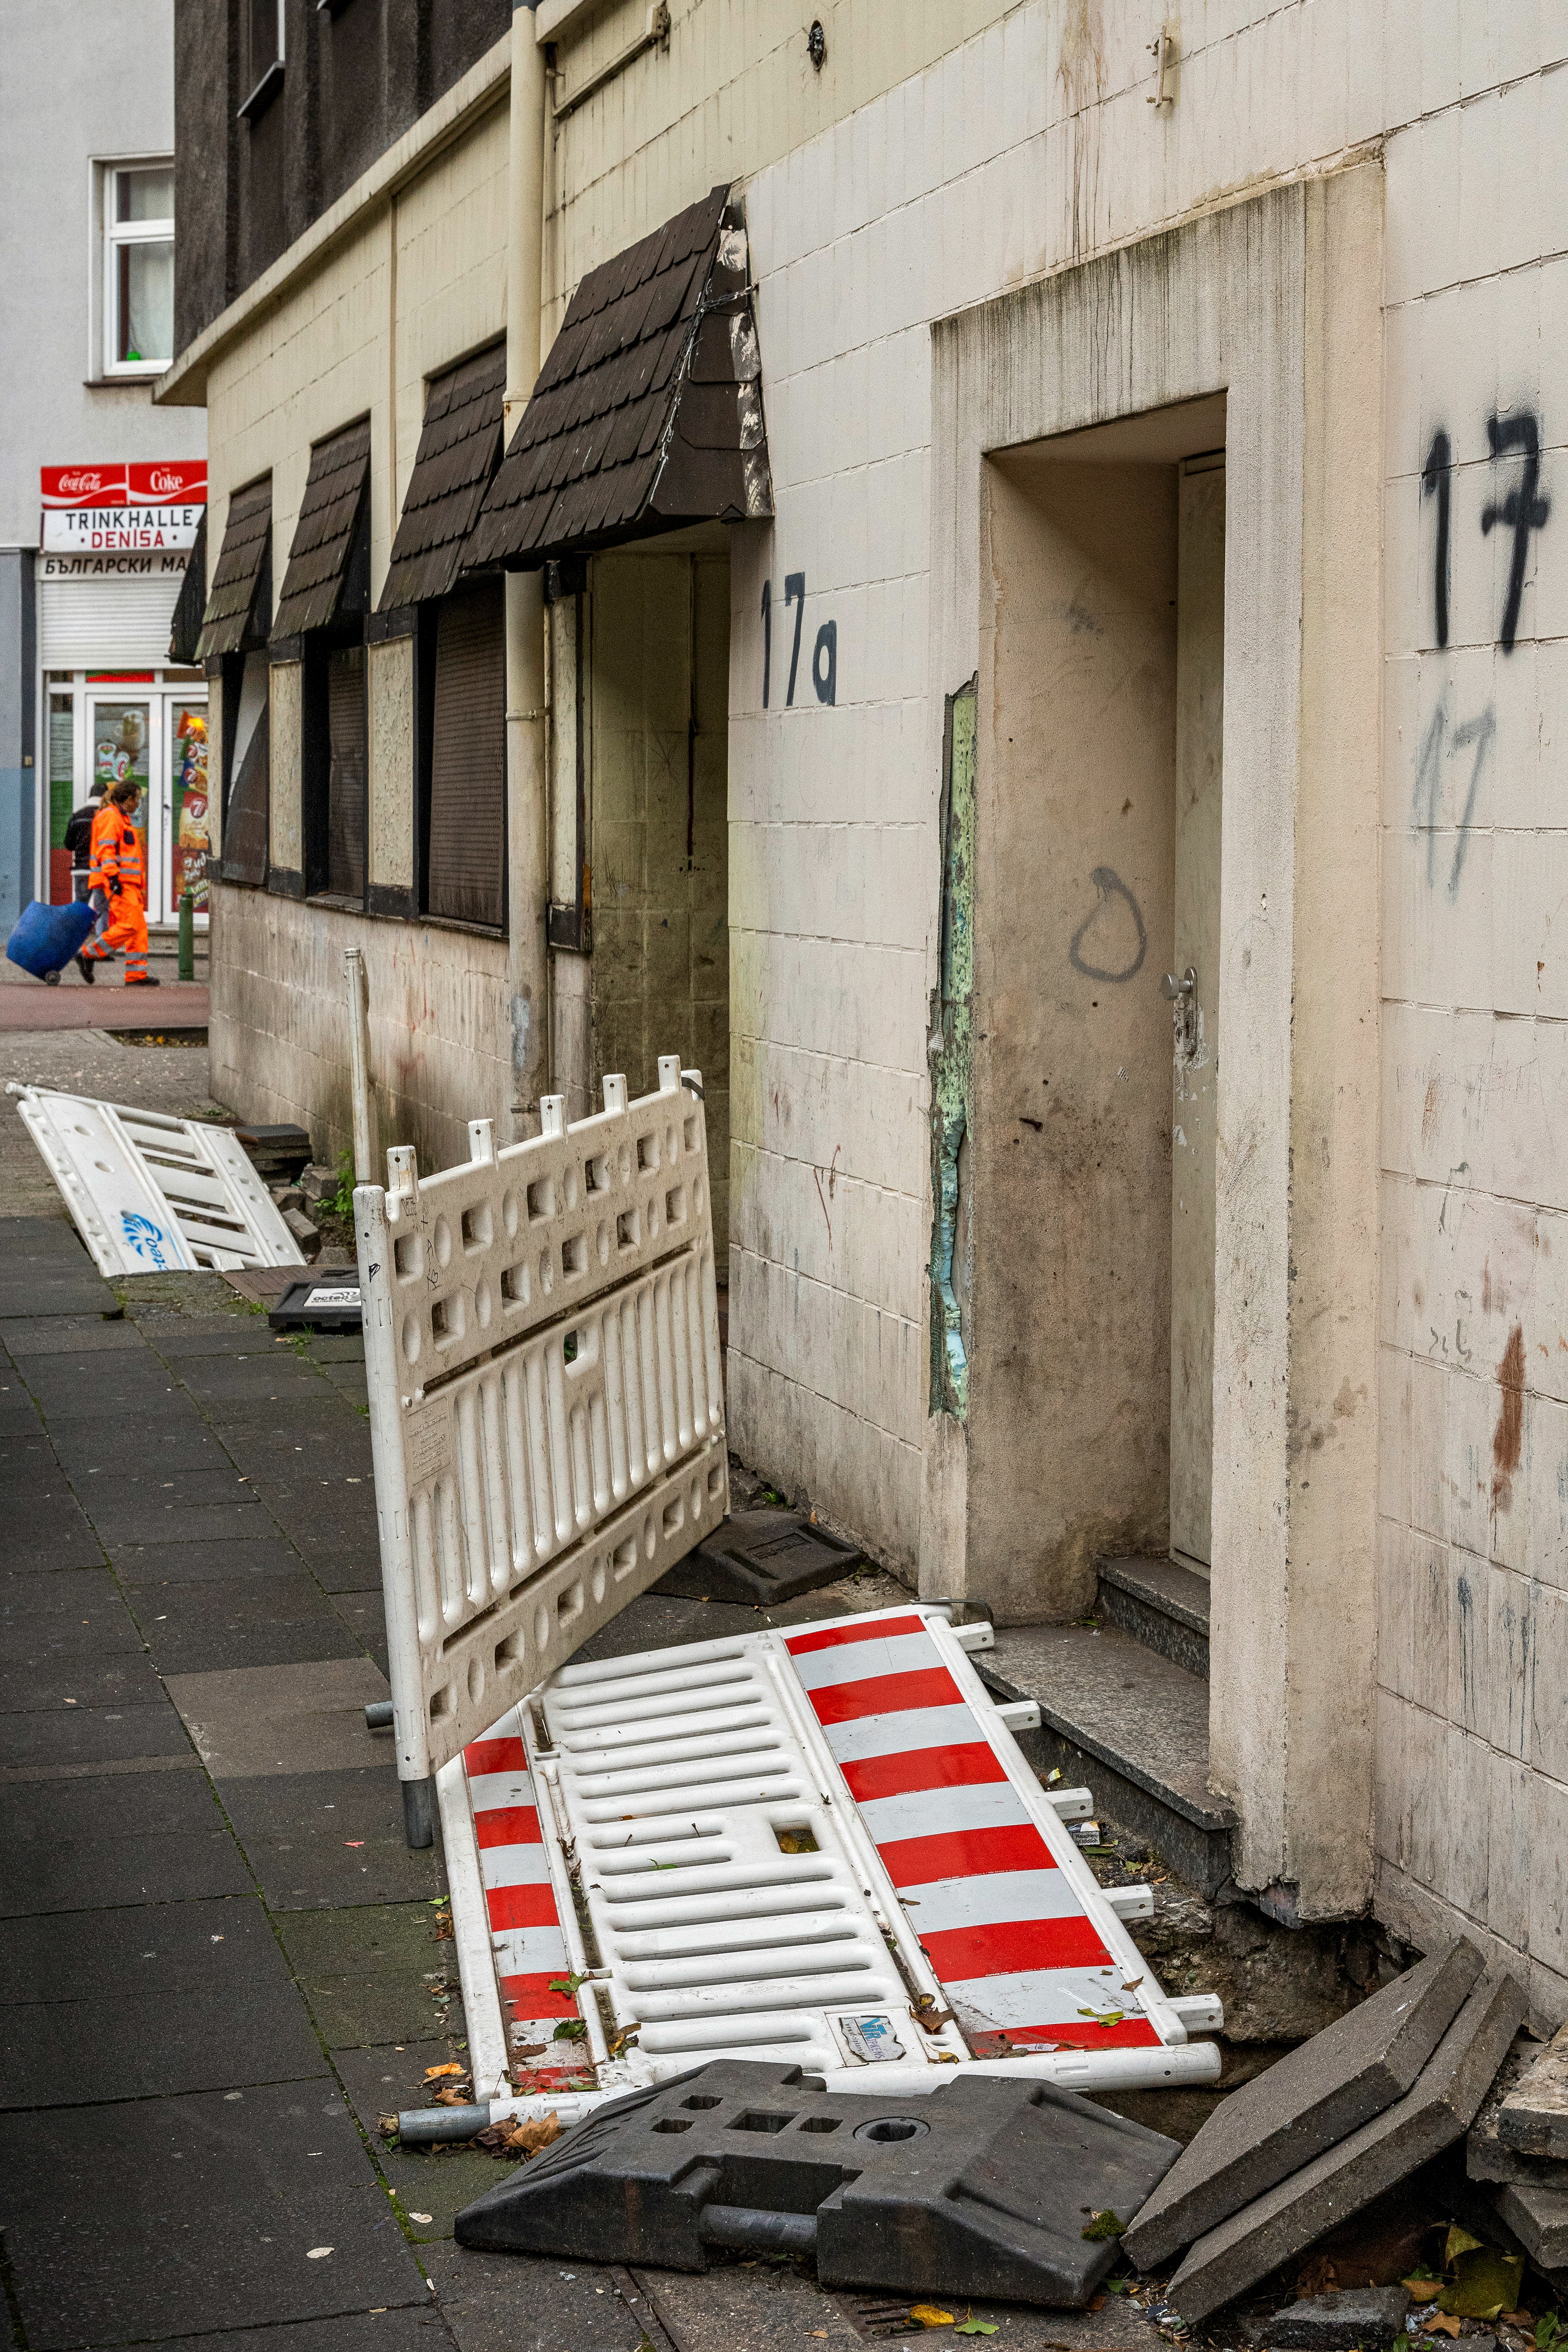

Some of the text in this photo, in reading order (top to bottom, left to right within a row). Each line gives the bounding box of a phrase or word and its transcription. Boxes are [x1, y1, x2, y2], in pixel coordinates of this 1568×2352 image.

[150, 470, 184, 492] Coke
[66, 509, 193, 530] TRINKHALLE
[92, 529, 165, 548] DENISA
[1421, 411, 1550, 655] 17
[46, 557, 151, 574] БЪЛГАРСКИ
[761, 572, 837, 708] 17a
[145, 1238, 169, 1270] cteo
